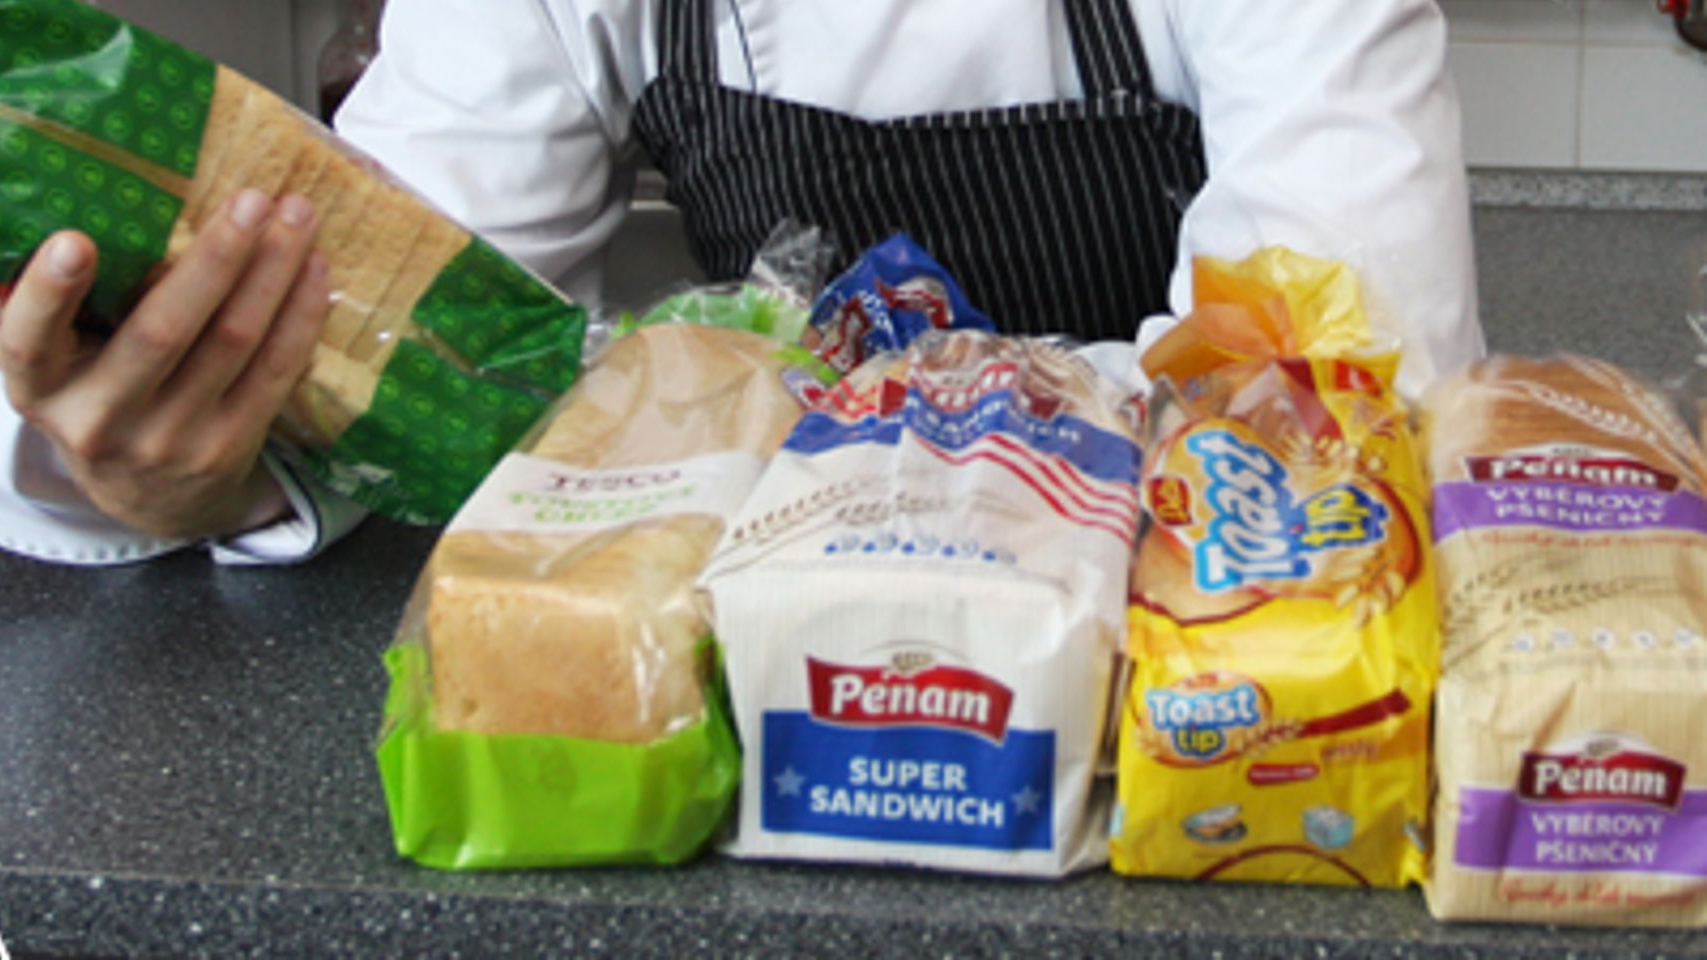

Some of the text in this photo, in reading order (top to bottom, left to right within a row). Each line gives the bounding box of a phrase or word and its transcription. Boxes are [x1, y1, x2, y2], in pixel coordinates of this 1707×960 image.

[547, 468, 682, 491] TESCO
[1488, 455, 1658, 486] Penam
[1197, 436, 1294, 583] Toast
[828, 672, 993, 724] Penam
[1151, 689, 1254, 726] Toast
[848, 756, 969, 791] SUPER
[1533, 759, 1669, 798] Penam
[809, 785, 1005, 829] SANDWICH
